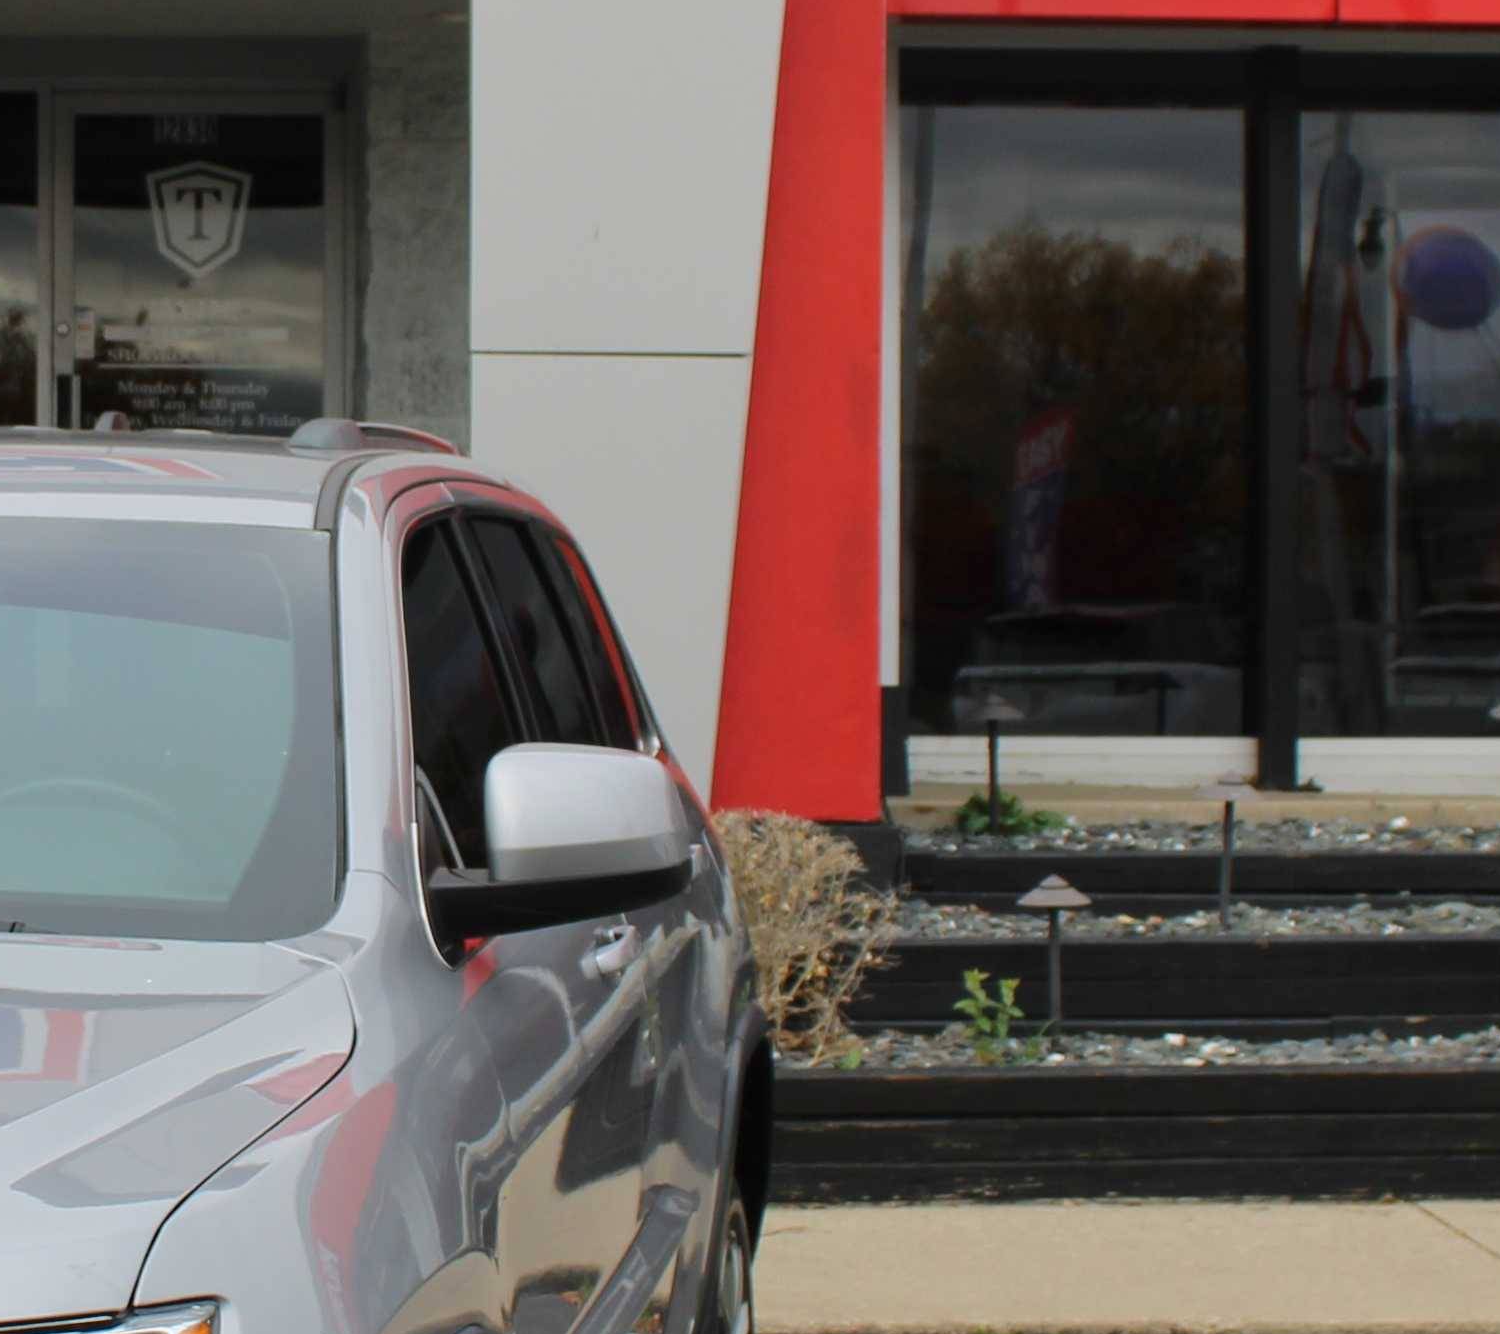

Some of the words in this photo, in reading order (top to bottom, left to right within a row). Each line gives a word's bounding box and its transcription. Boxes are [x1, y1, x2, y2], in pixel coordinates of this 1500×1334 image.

[176, 187, 222, 241] T
[117, 380, 178, 397] Monday
[201, 380, 269, 399] Thursday
[151, 413, 237, 430] Wednesday
